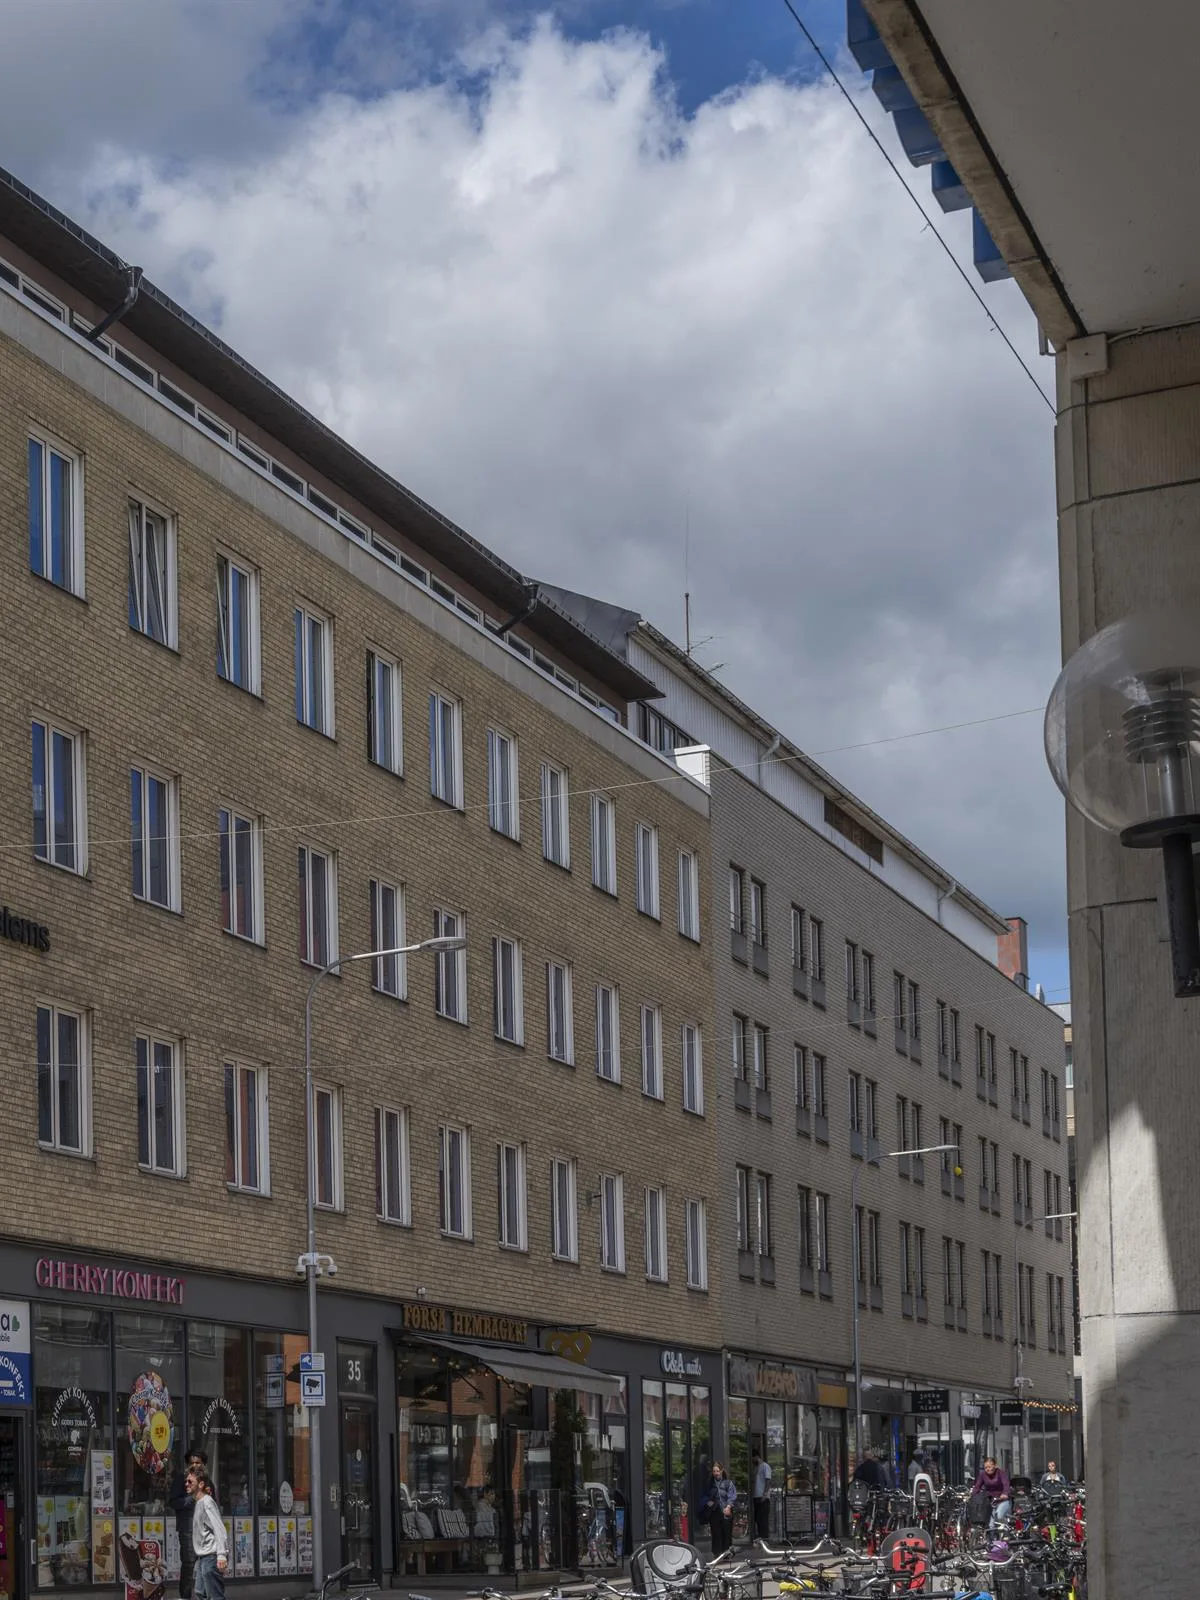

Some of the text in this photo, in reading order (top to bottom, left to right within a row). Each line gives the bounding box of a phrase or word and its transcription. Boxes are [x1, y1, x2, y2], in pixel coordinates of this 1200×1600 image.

[35, 1257, 186, 1305] CHERRY KONFEKT
[452, 1311, 528, 1343] HEMBAGERI
[348, 1360, 361, 1381] 35
[663, 1351, 685, 1374] C&A
[52, 1386, 72, 1427] CHERRY
[72, 1386, 97, 1428] KONFEKT
[202, 1398, 219, 1435] CHERRY
[219, 1397, 240, 1435] KONFEKT
